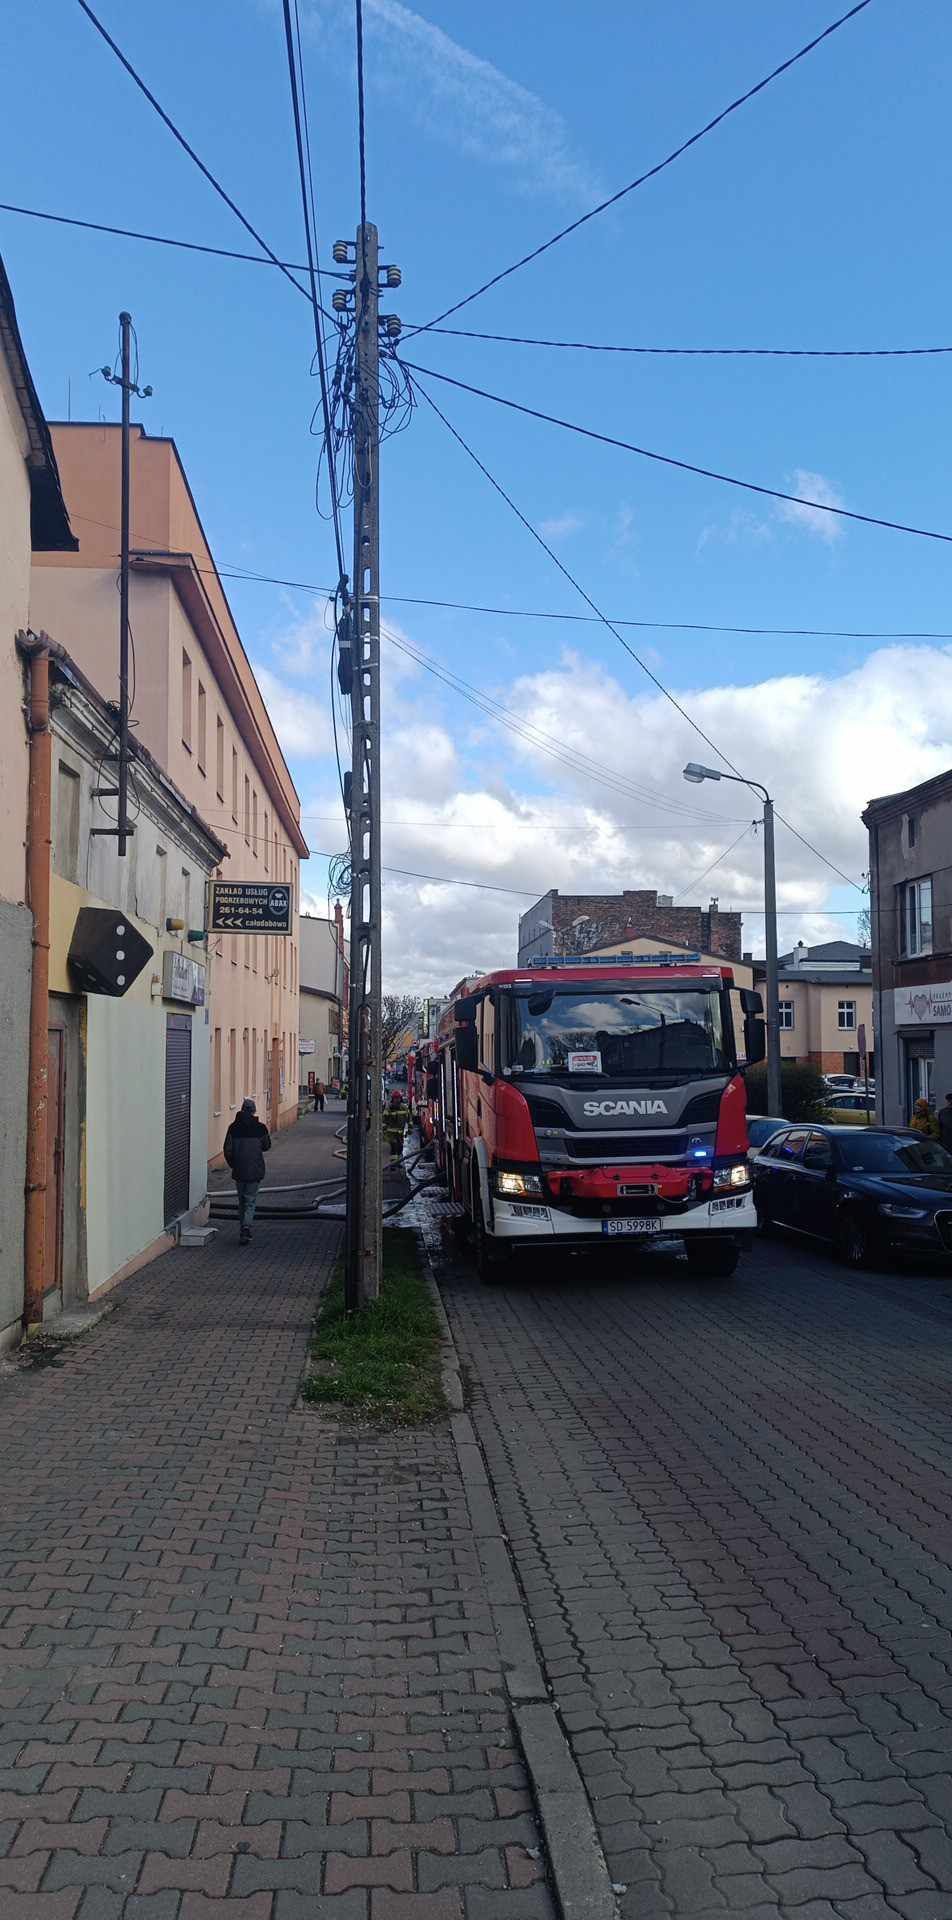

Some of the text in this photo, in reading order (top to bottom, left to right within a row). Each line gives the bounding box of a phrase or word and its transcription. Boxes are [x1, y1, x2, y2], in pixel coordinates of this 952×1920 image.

[215, 887, 268, 896] ZAKŁAD USŁUG
[215, 896, 268, 905] POGRZEBOWYCH
[219, 907, 263, 915] 261-64-54
[245, 919, 287, 928] całodobowo
[583, 1100, 669, 1116] SCANIA
[609, 1220, 657, 1231] SD 5998K
